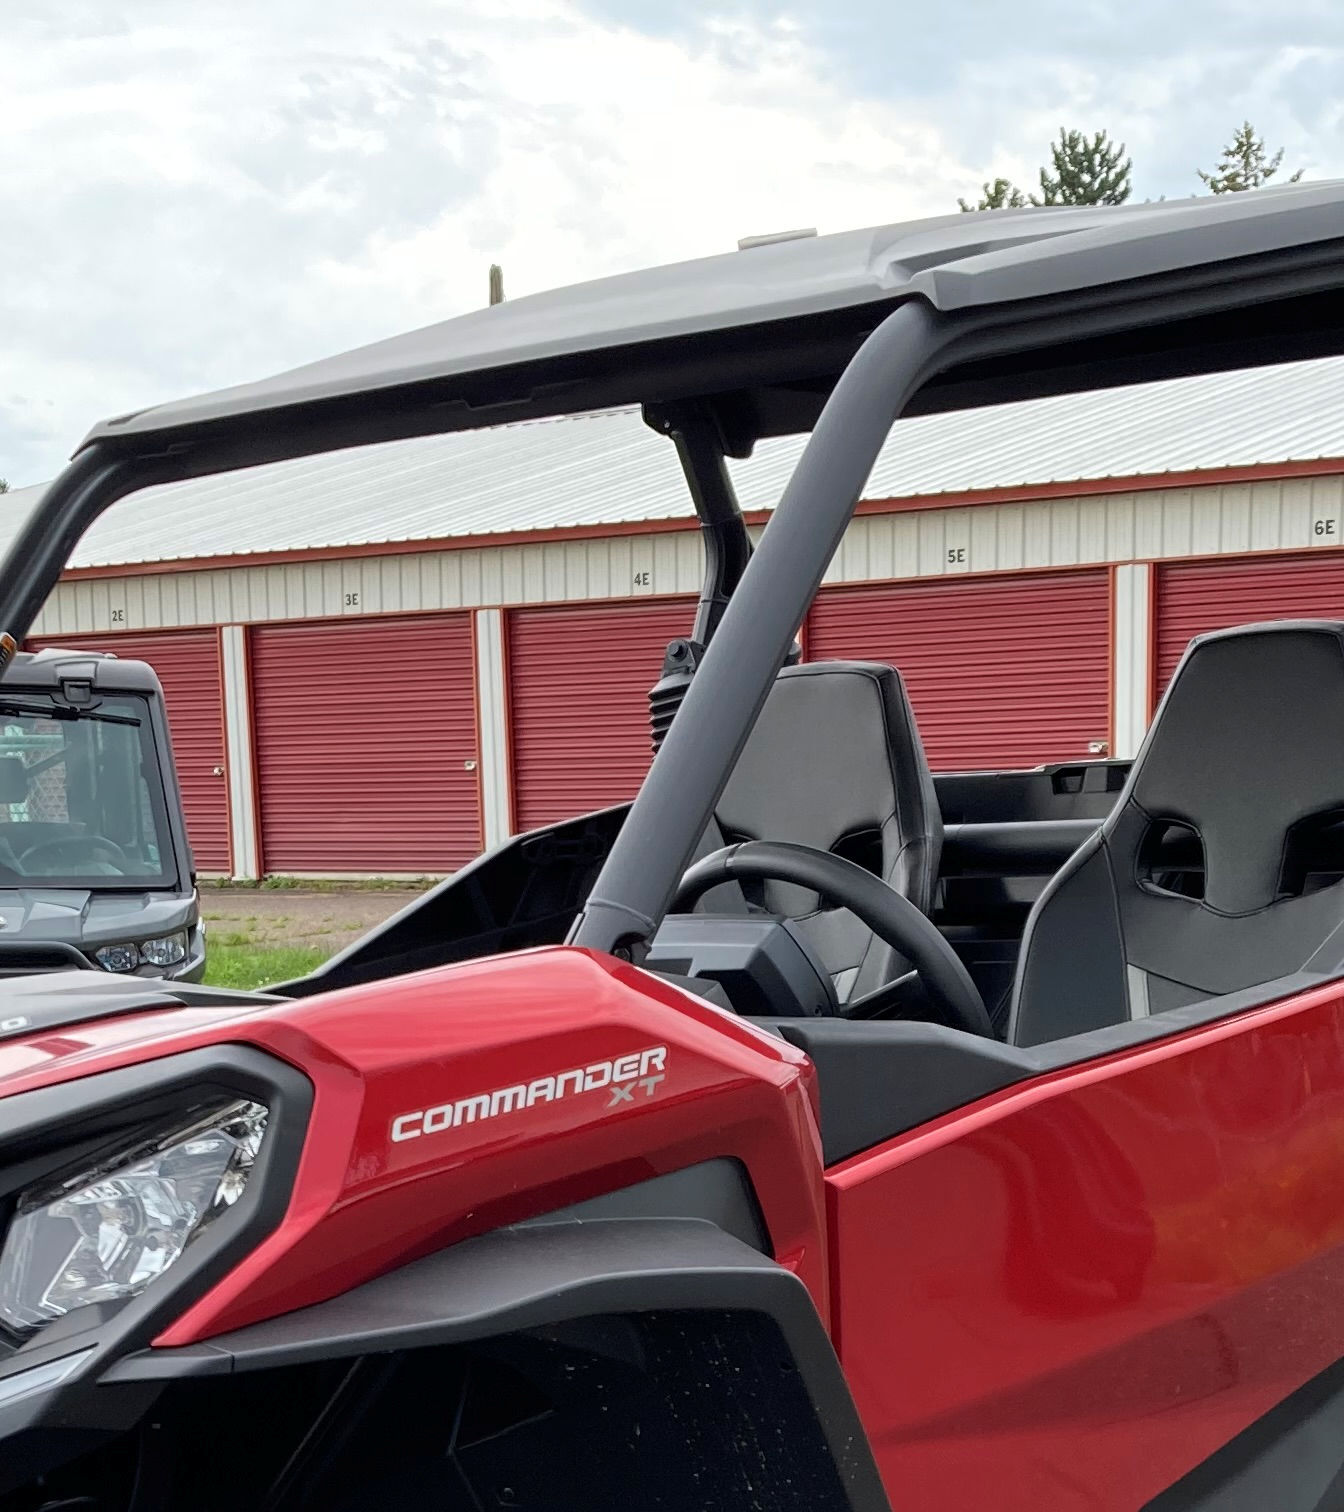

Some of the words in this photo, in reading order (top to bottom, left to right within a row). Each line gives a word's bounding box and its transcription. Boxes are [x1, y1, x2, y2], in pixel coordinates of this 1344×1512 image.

[1314, 520, 1335, 535] 6E
[947, 549, 965, 563] 5E
[634, 572, 649, 586] 4E
[345, 593, 359, 606] 3E
[112, 610, 124, 622] 2E
[391, 1046, 667, 1143] COMMANDER
[607, 1074, 665, 1107] XT
